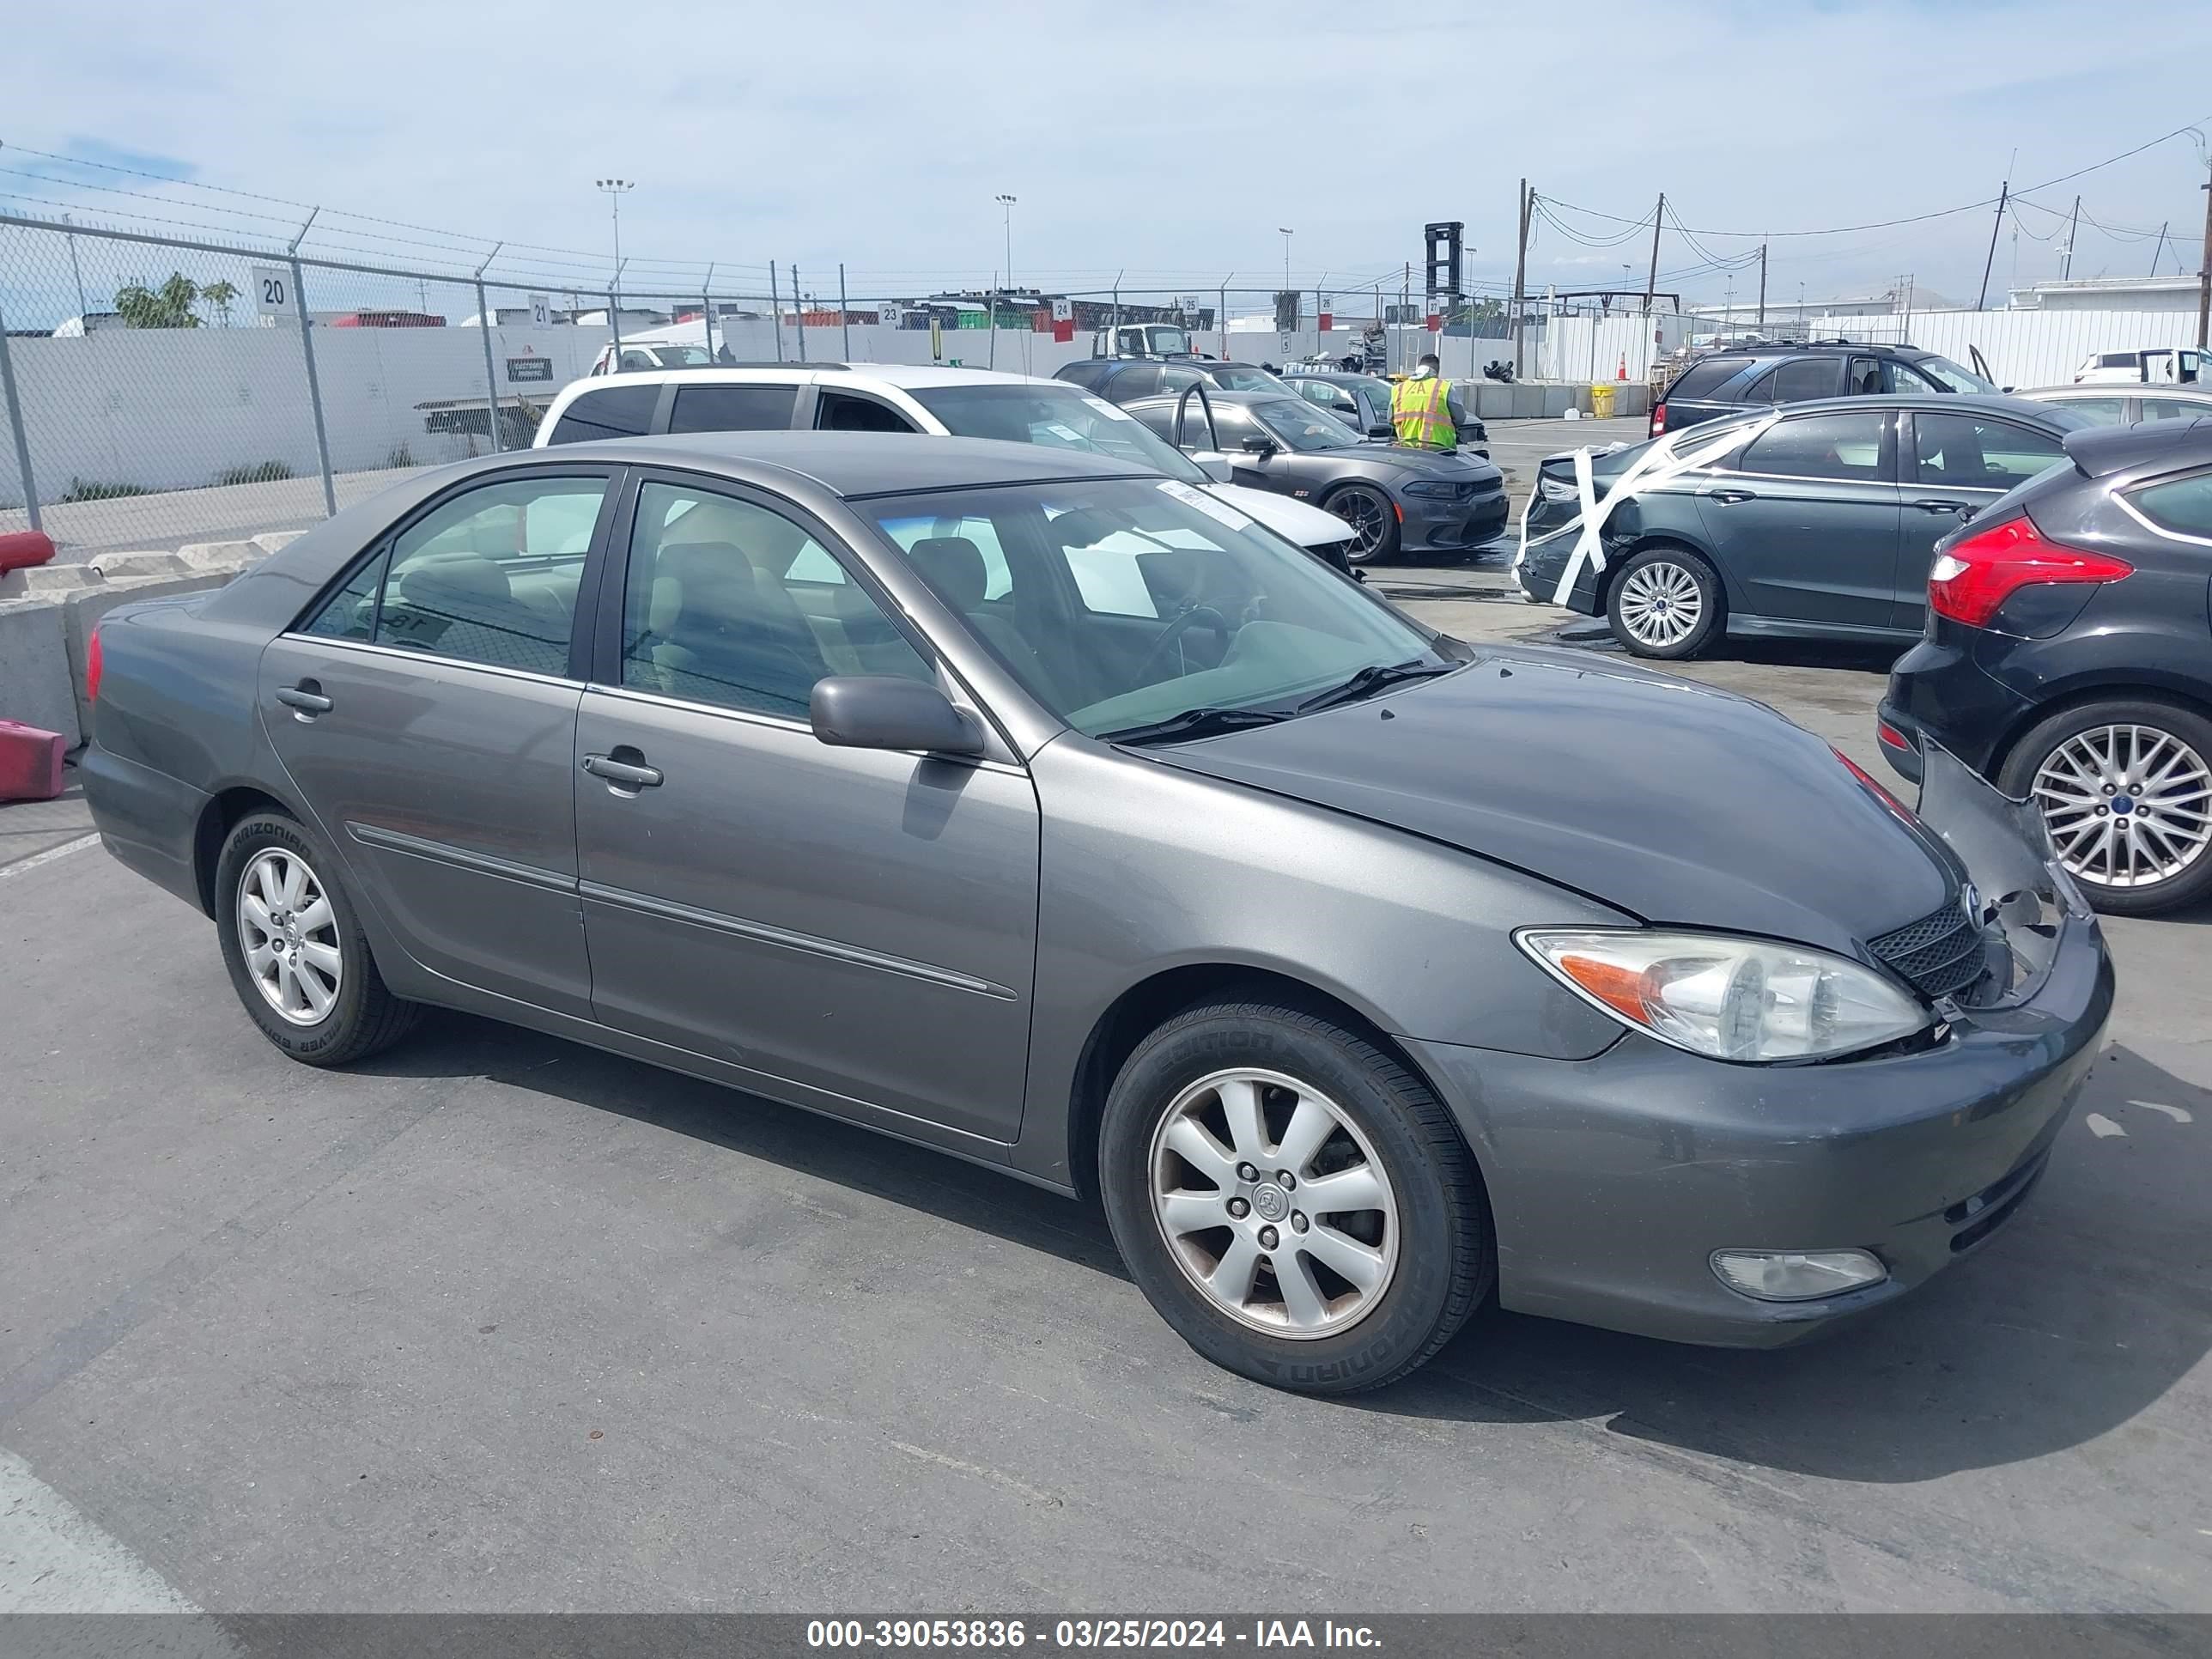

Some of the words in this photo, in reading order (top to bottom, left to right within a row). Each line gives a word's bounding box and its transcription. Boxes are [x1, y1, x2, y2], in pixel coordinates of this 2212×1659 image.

[264, 279, 284, 305] 20
[1057, 304, 1067, 315] 24
[1186, 301, 1195, 310] 25
[535, 304, 546, 323] 21
[884, 308, 896, 320] 23
[233, 823, 312, 859] ARIZONIAN
